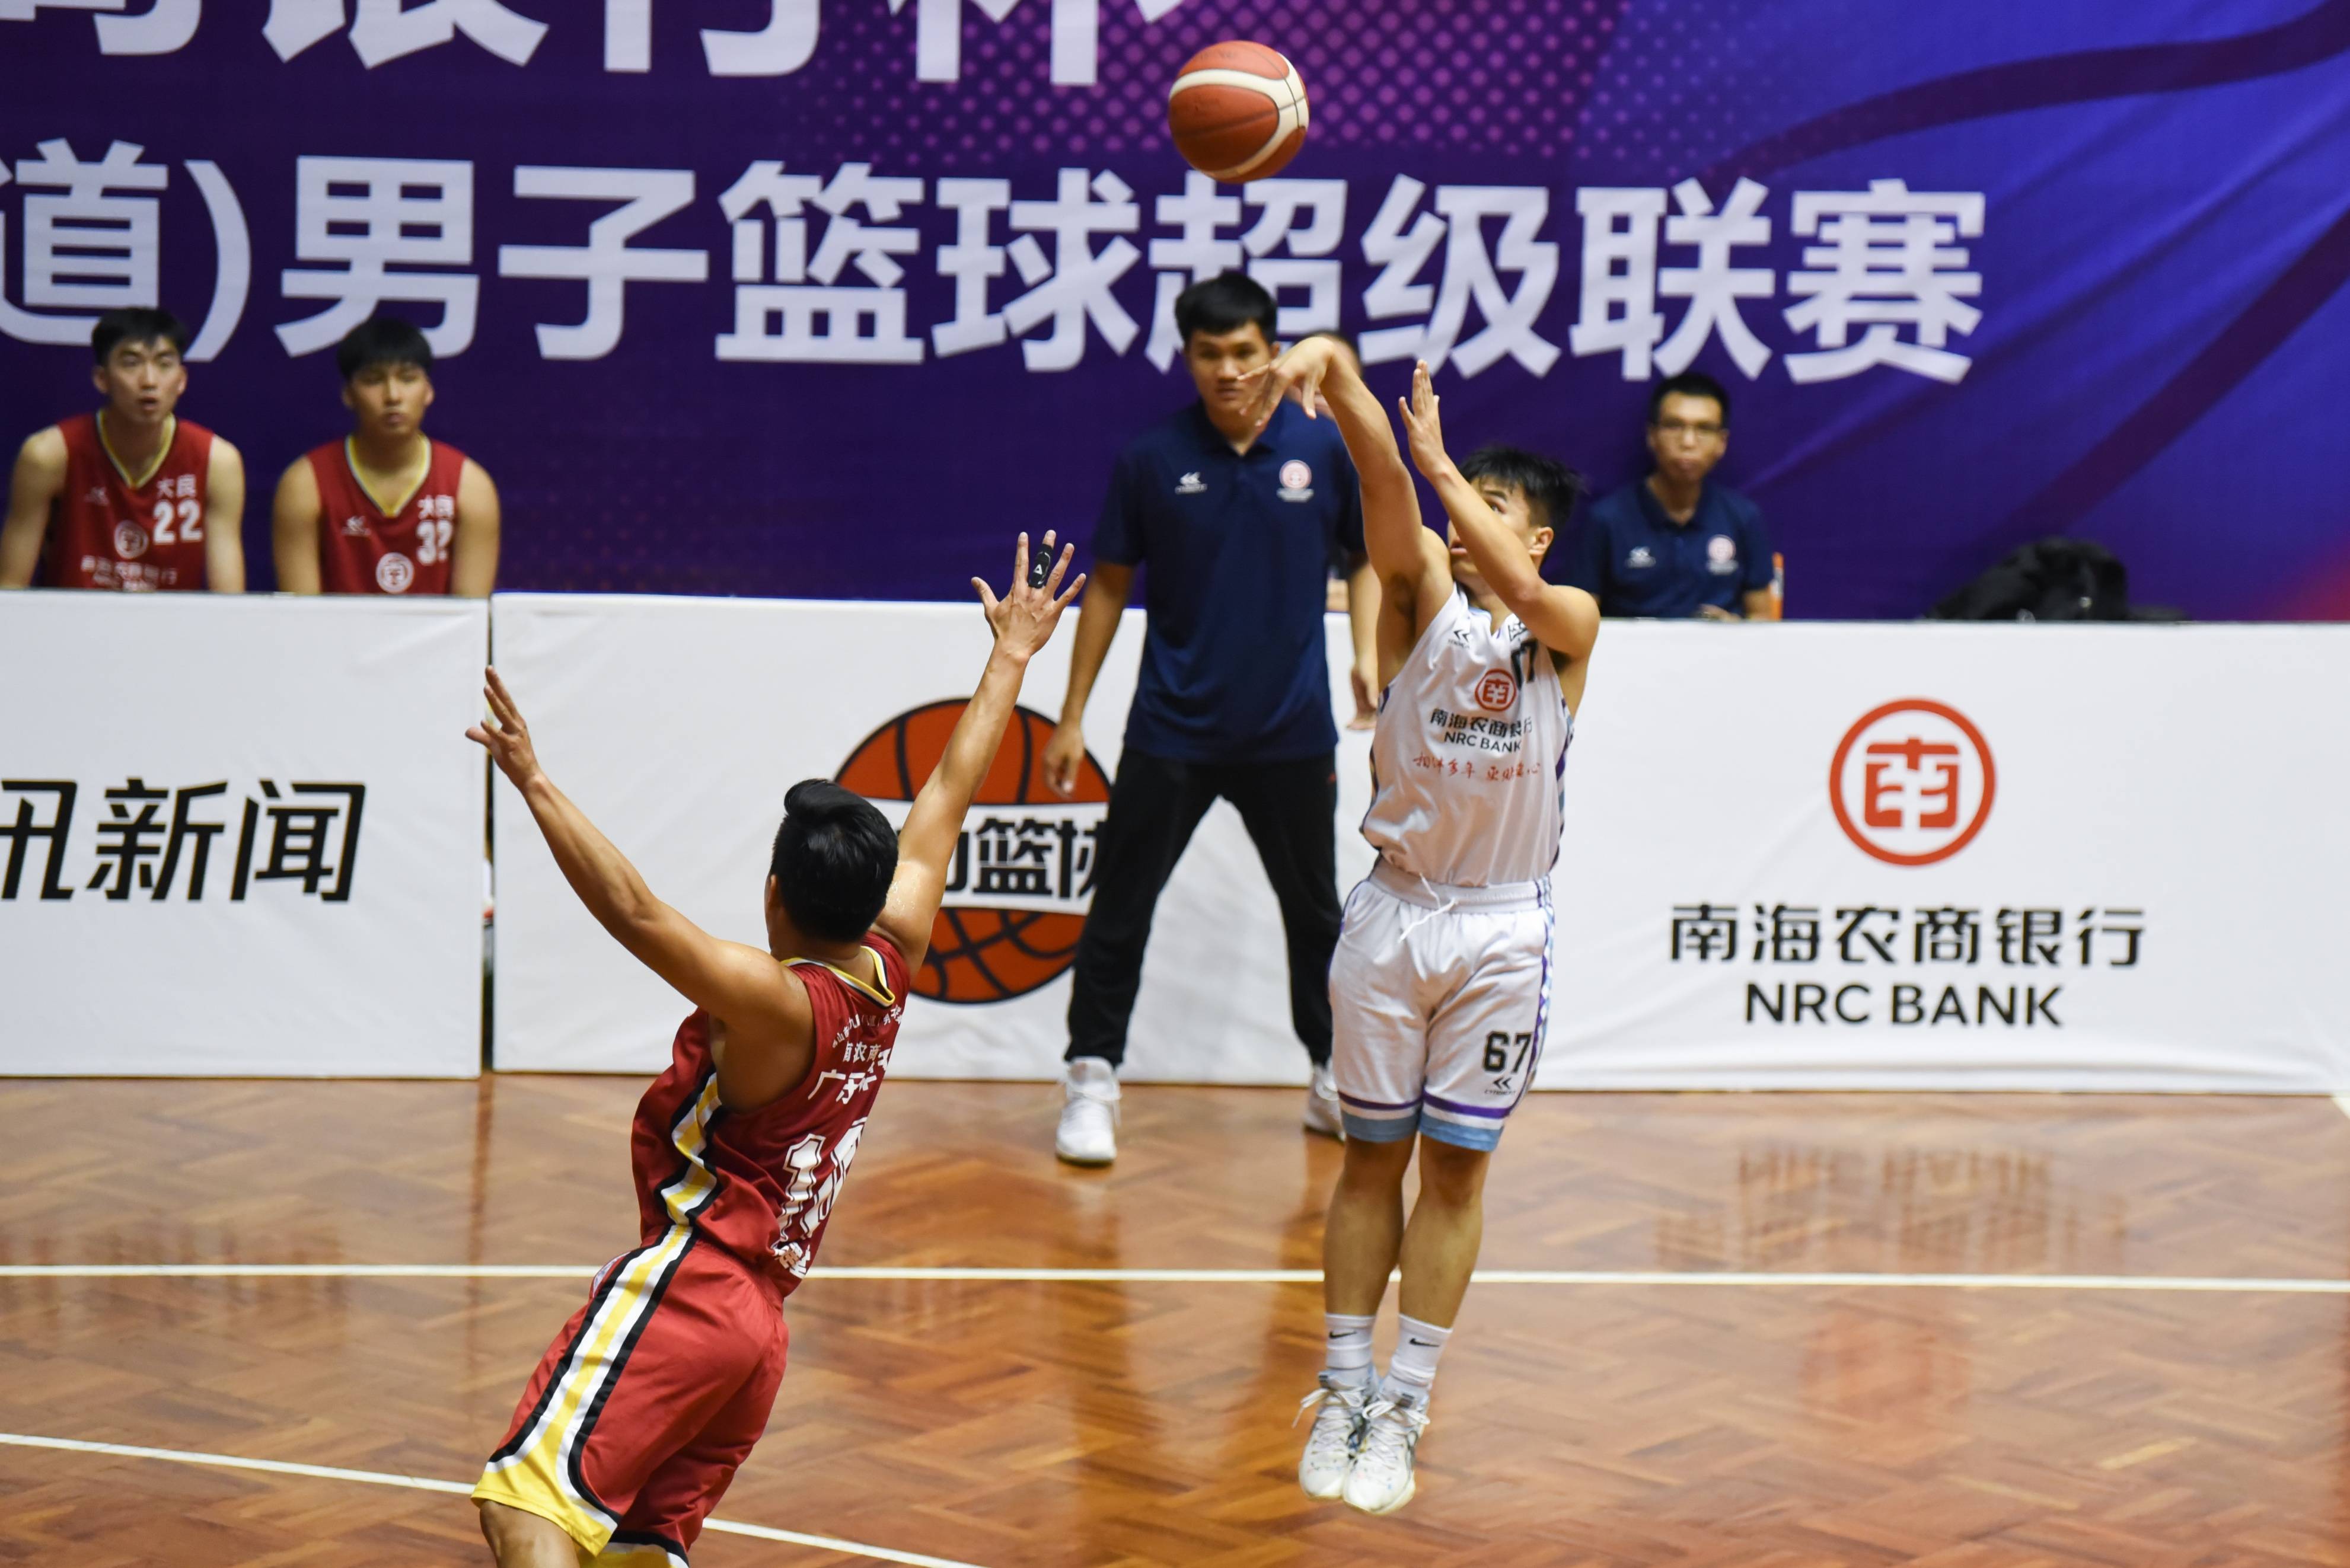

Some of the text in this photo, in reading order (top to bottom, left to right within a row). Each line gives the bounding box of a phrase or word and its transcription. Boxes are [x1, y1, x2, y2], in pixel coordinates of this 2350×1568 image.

[153, 499, 203, 545] 22
[1445, 732, 1522, 752] NRC BANK
[1670, 902, 2145, 967] 南海农商银行
[1745, 983, 2064, 1026] NRC BANK
[1484, 1031, 1534, 1075] 67
